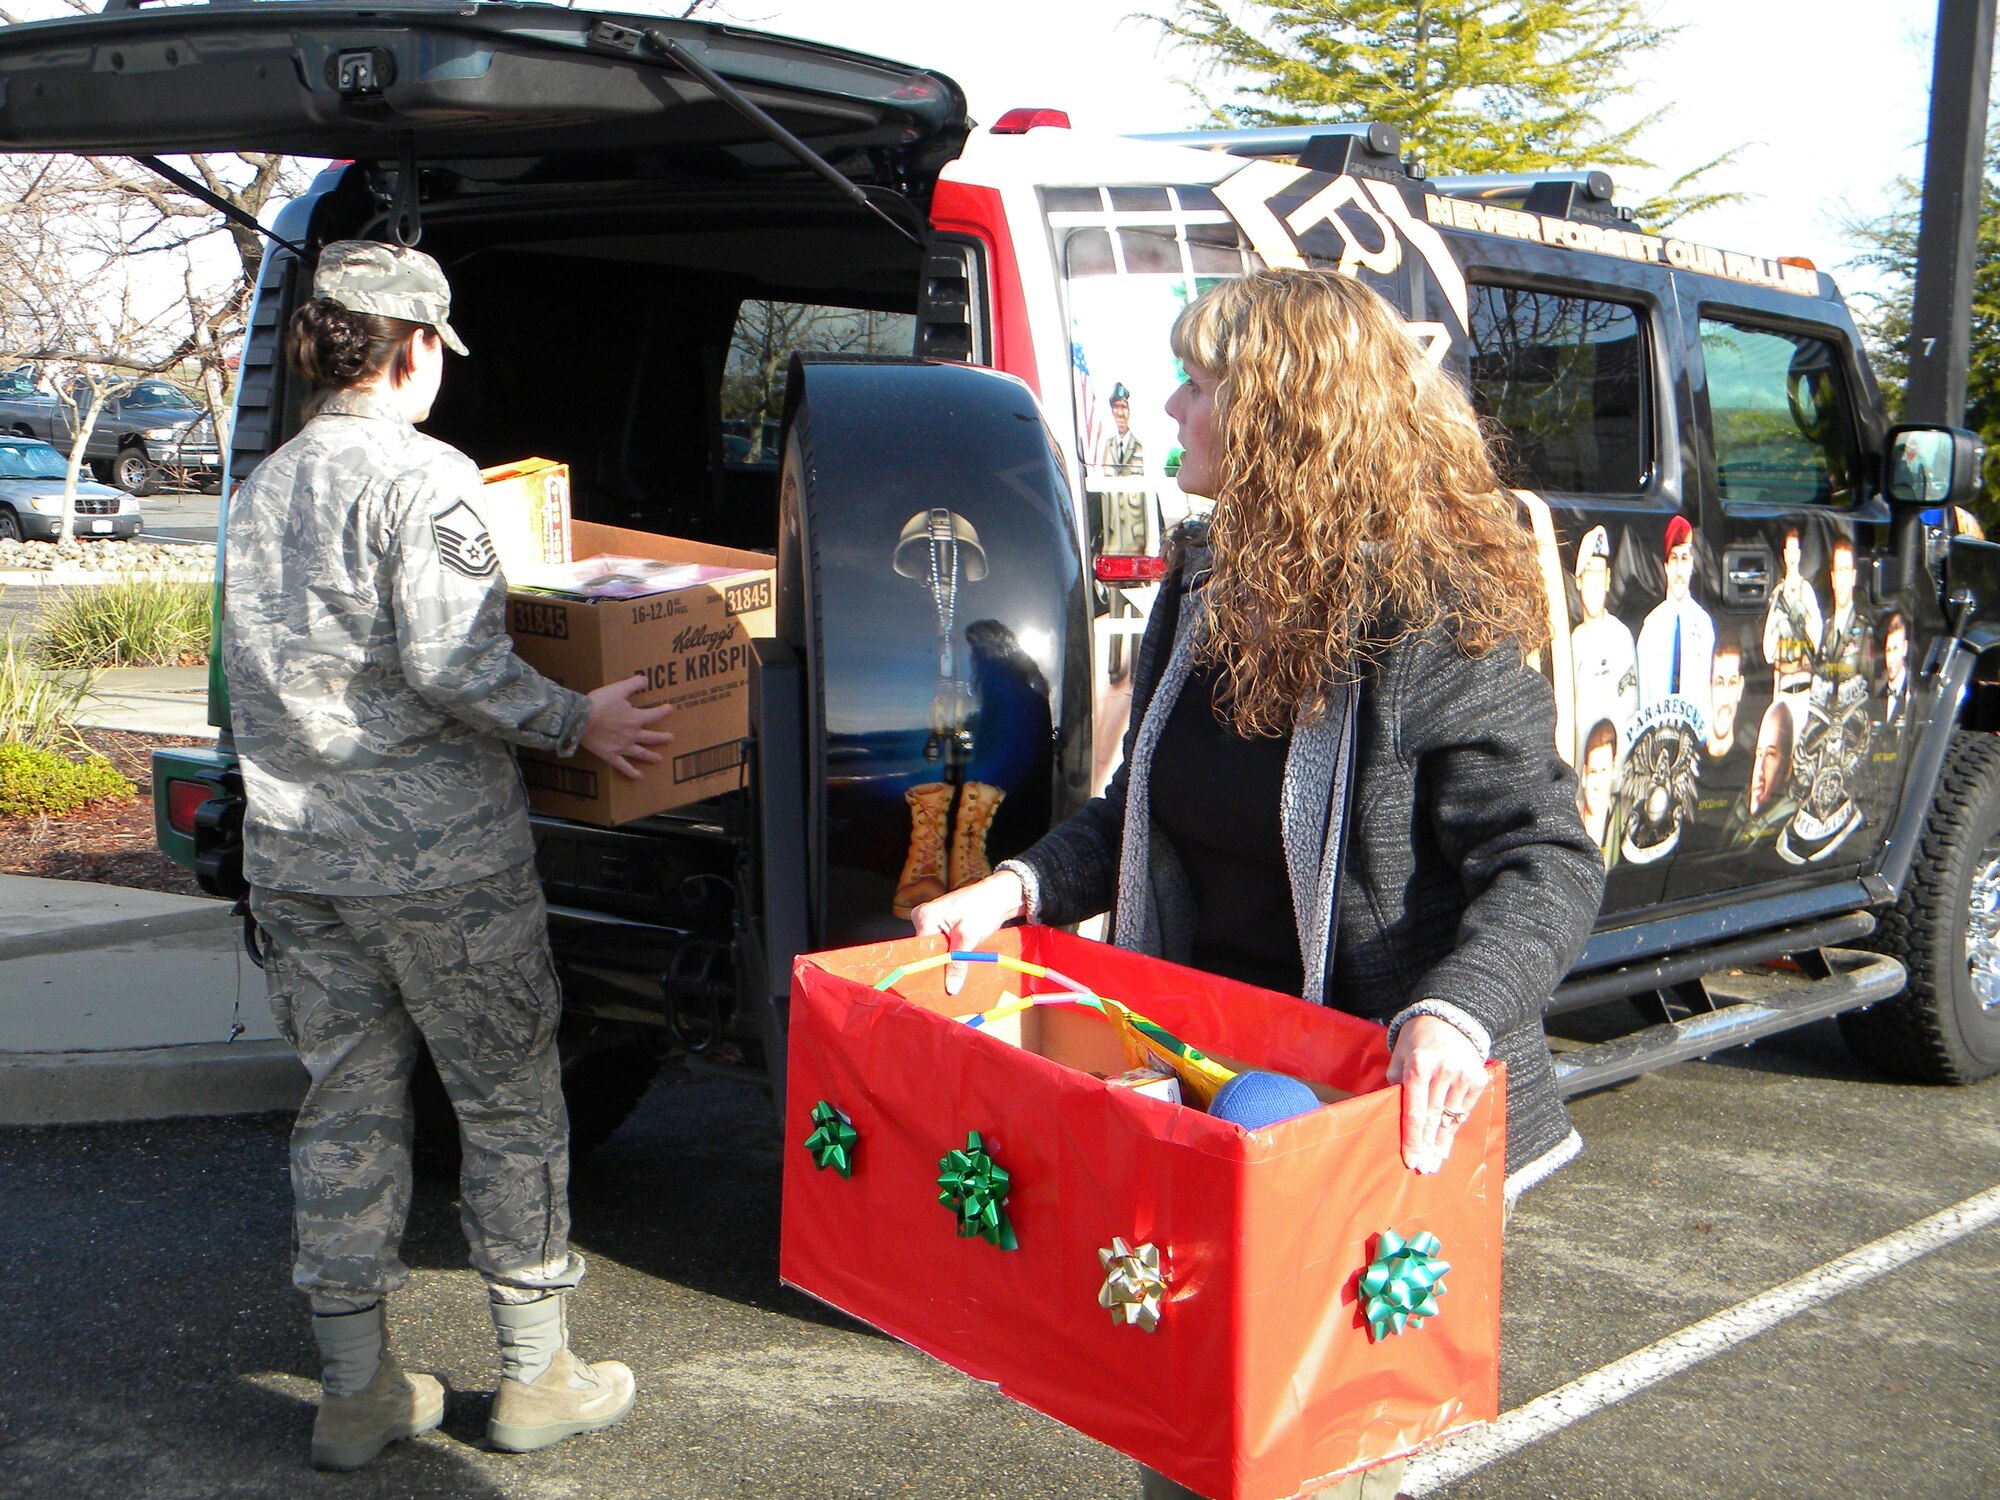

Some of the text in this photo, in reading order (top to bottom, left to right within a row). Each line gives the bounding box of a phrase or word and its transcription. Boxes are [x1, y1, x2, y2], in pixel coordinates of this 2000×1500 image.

[1424, 192, 1820, 297] NEVER FORGET OUR FALLEN
[1921, 336, 1937, 357] 7
[726, 581, 770, 614] 31845
[514, 602, 567, 638] 31845
[685, 643, 747, 681] KRISPI
[1626, 698, 1705, 742] PARARESCUE
